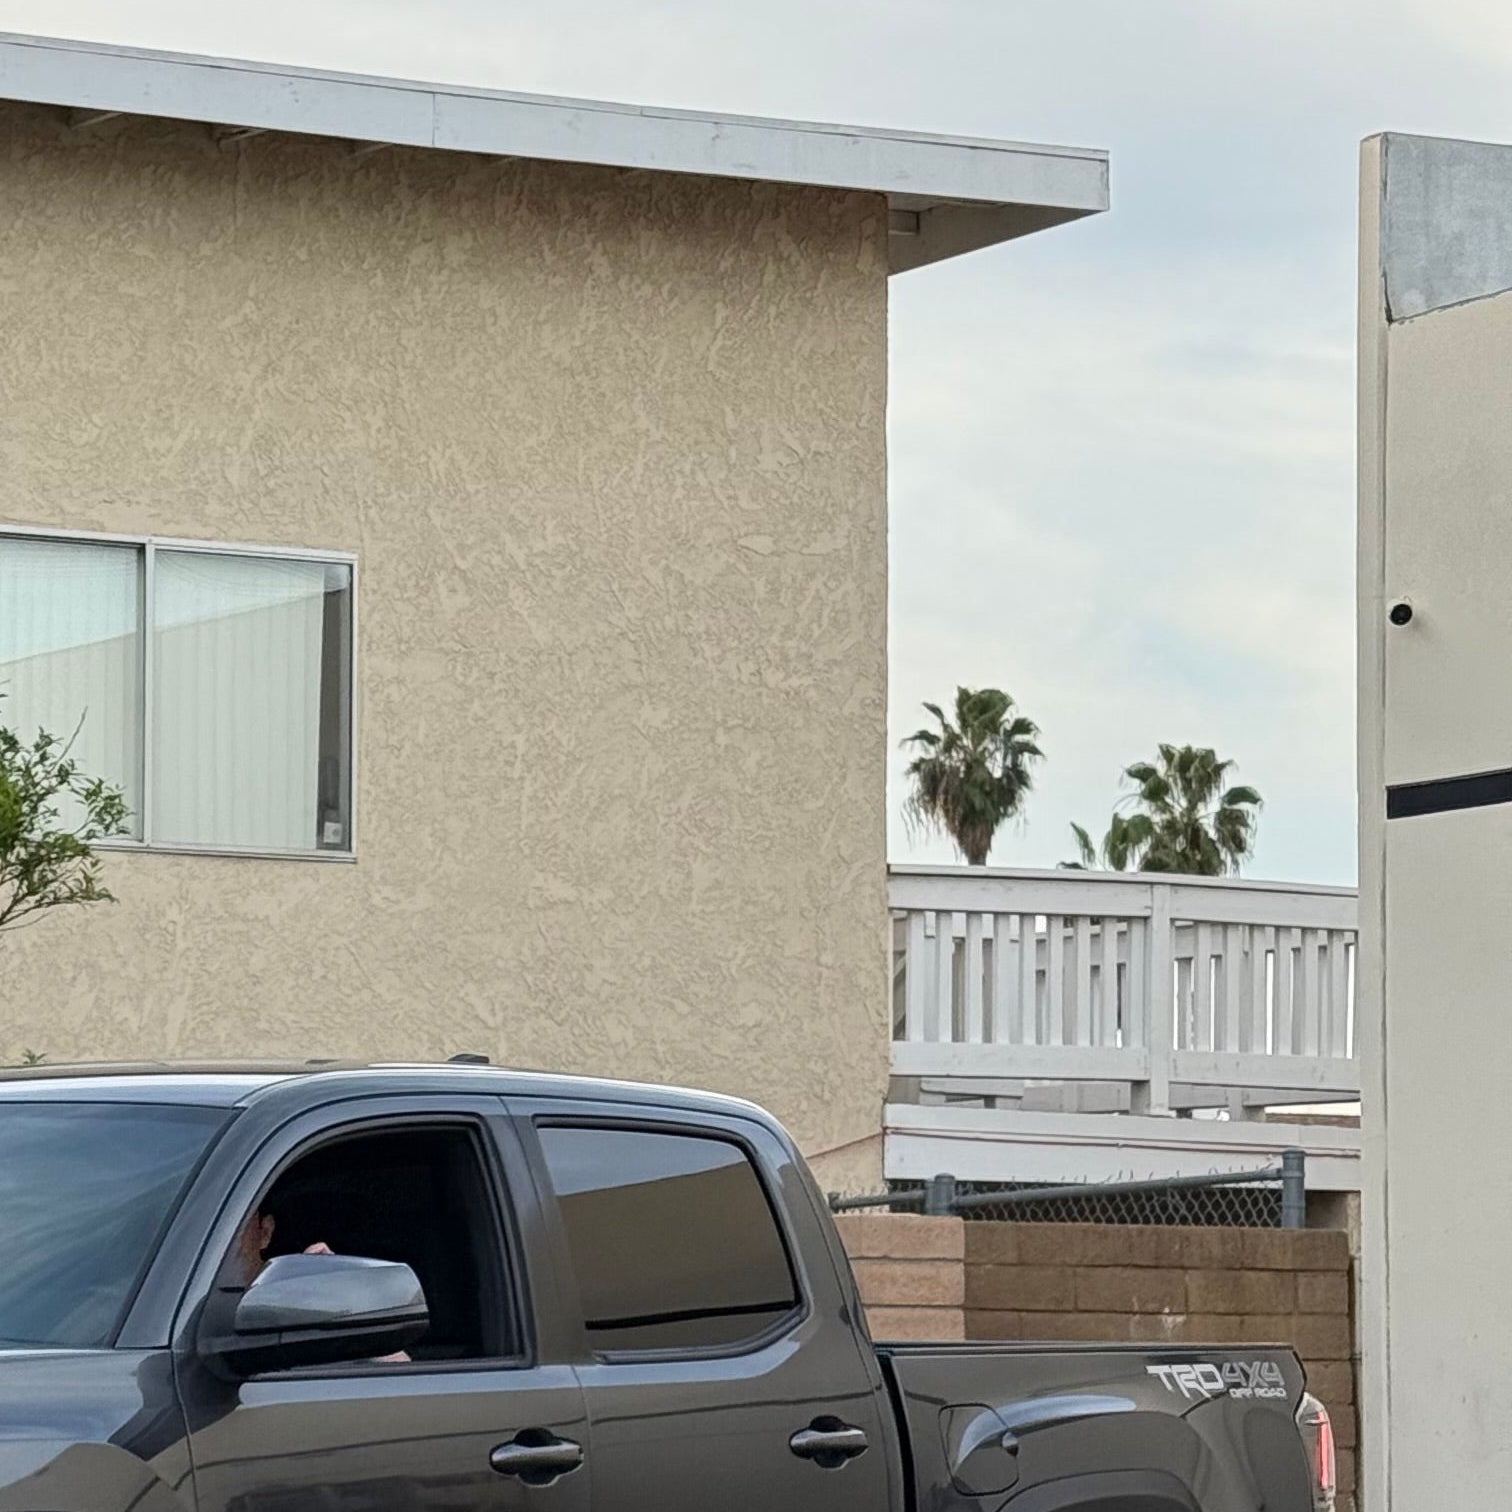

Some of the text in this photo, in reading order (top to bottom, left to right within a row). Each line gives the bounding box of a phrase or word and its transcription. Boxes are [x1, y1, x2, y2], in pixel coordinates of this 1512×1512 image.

[1146, 1364, 1224, 1398] TRD
[1229, 1387, 1287, 1399] OFF ROAD
